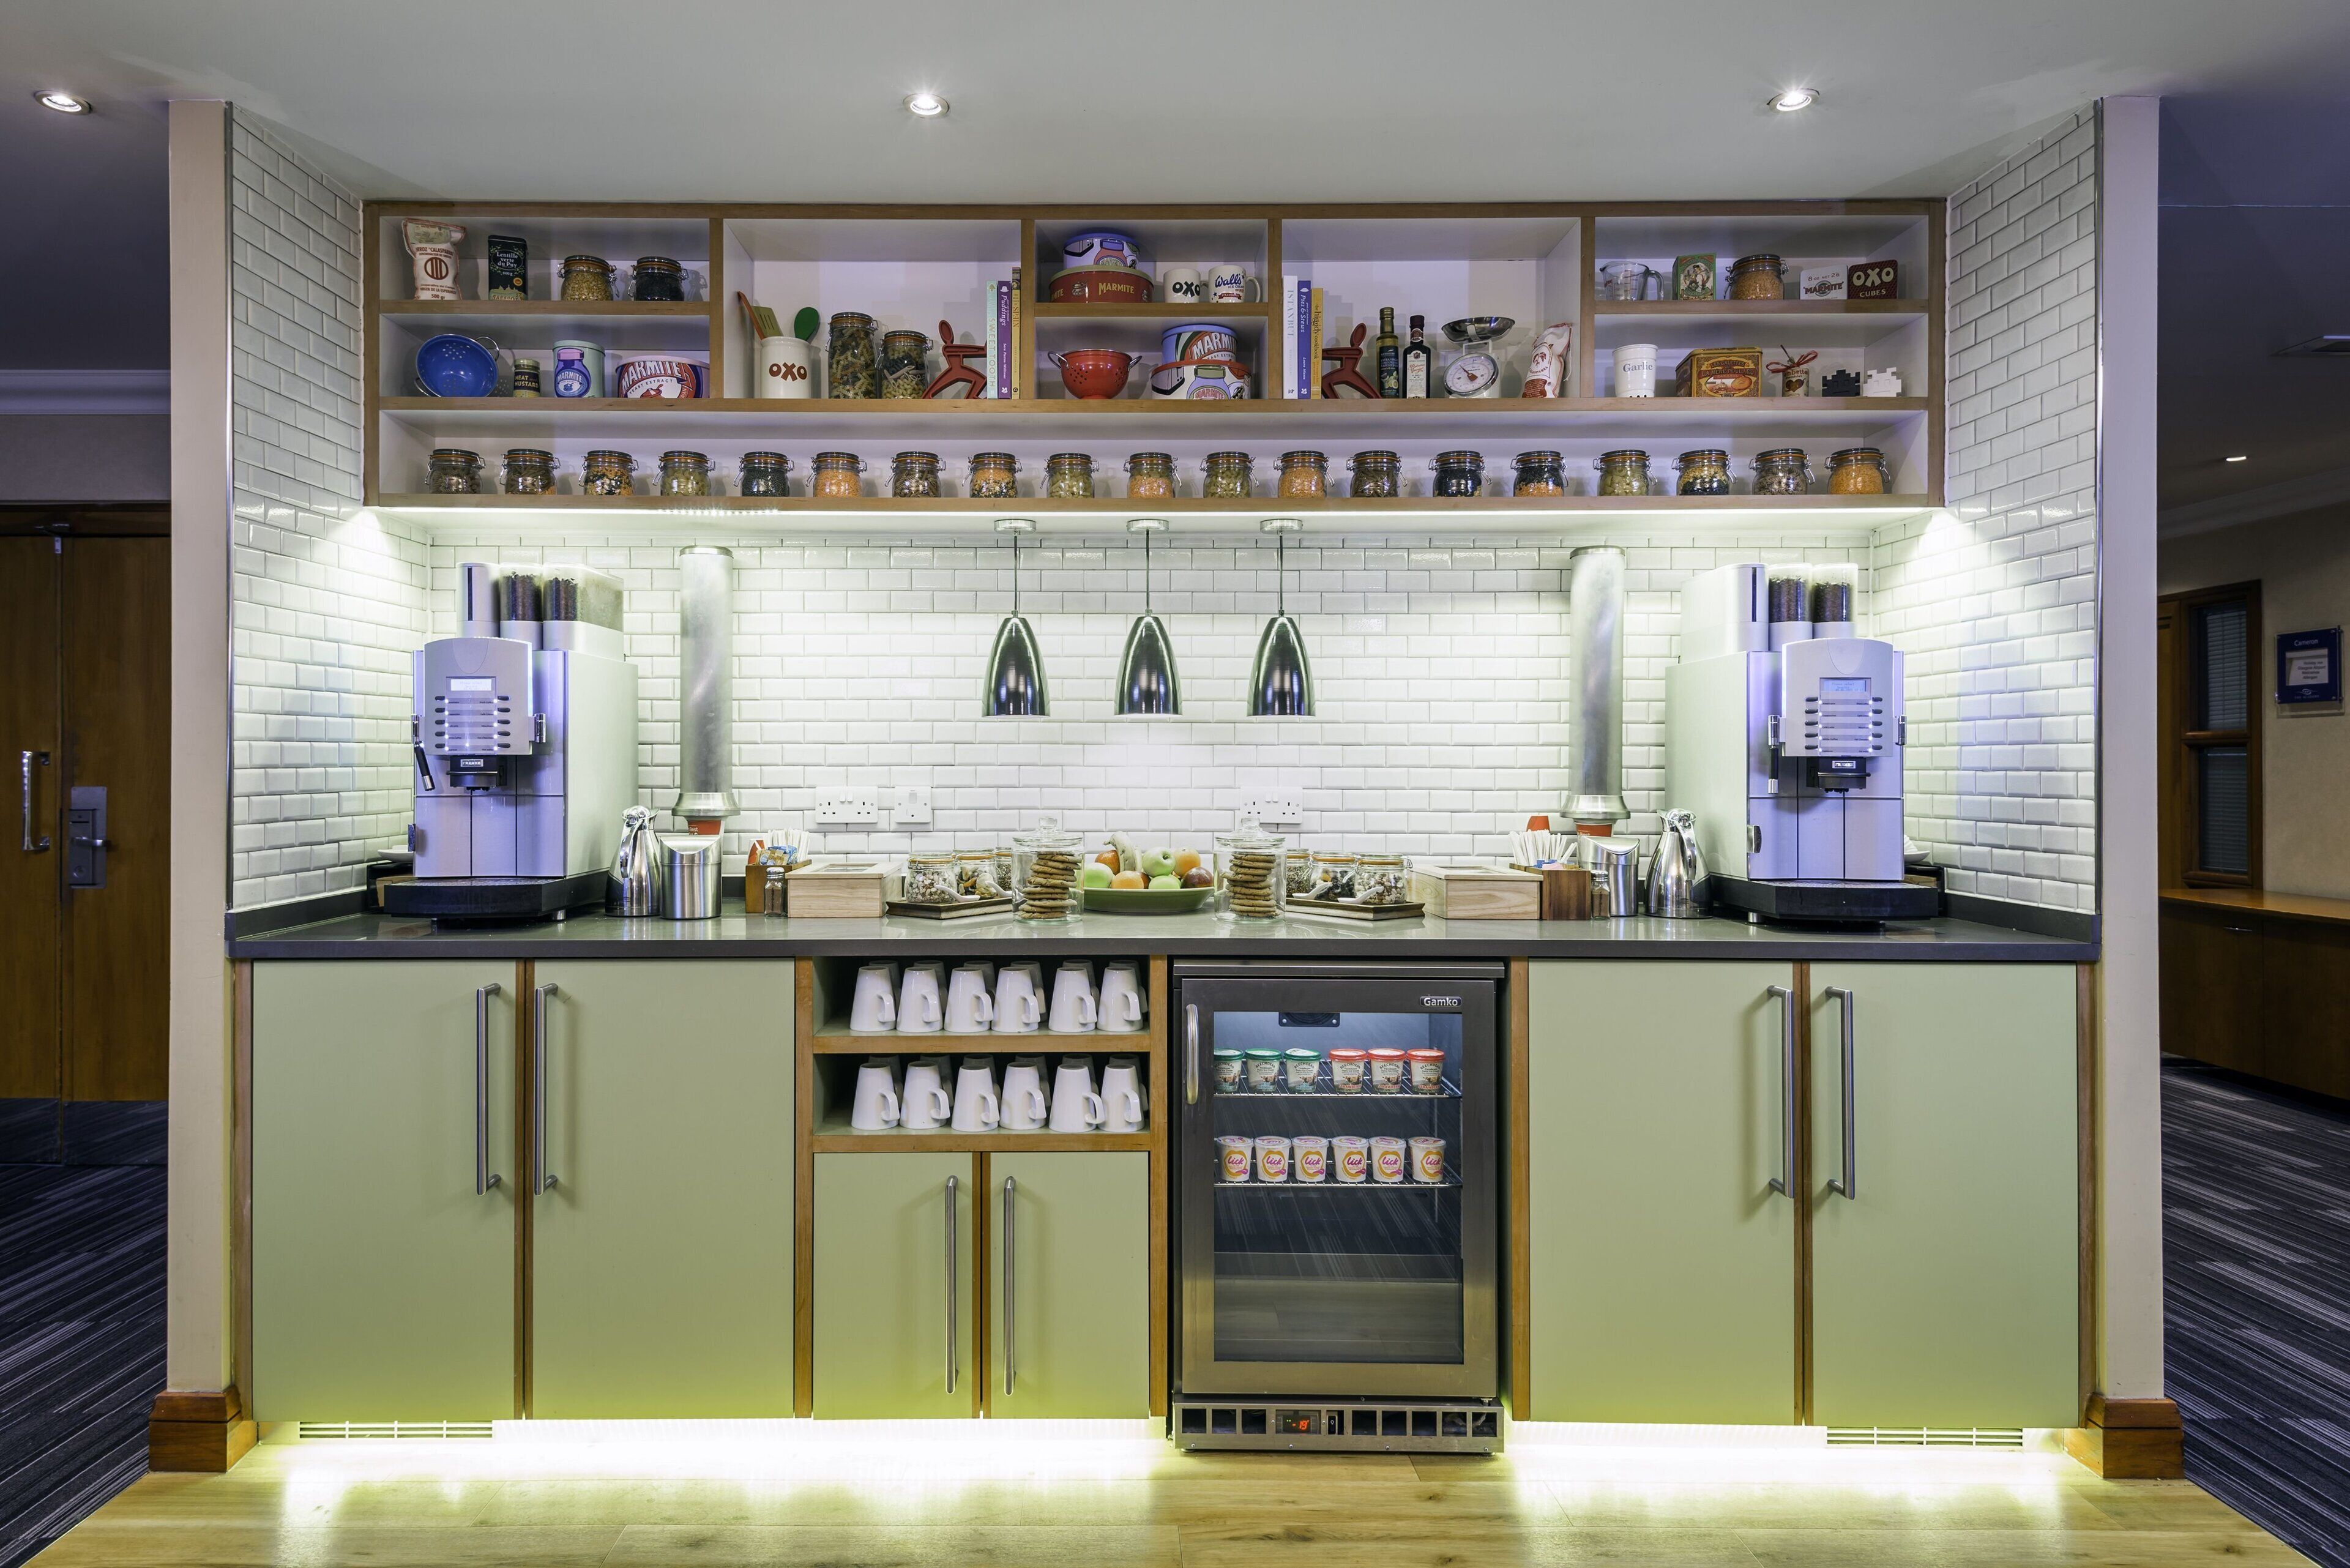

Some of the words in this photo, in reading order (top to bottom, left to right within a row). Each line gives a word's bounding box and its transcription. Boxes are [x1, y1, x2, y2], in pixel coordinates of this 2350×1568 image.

[1215, 274, 1242, 288] Wall's
[1852, 267, 1894, 287] OXO
[1099, 282, 1135, 296] MARMITE
[1173, 280, 1201, 297] OXO
[1859, 289, 1886, 297] CUBES
[1311, 311, 1322, 335] higgidy
[1193, 332, 1237, 360] MARMIT
[769, 362, 807, 381] OXO
[1623, 362, 1653, 373] Garlic
[558, 371, 583, 383] MARMITE
[622, 360, 682, 395] MARMITE
[629, 384, 644, 395] YEAST
[1195, 387, 1225, 399] MARMITE
[1423, 998, 1458, 1006] Gamko
